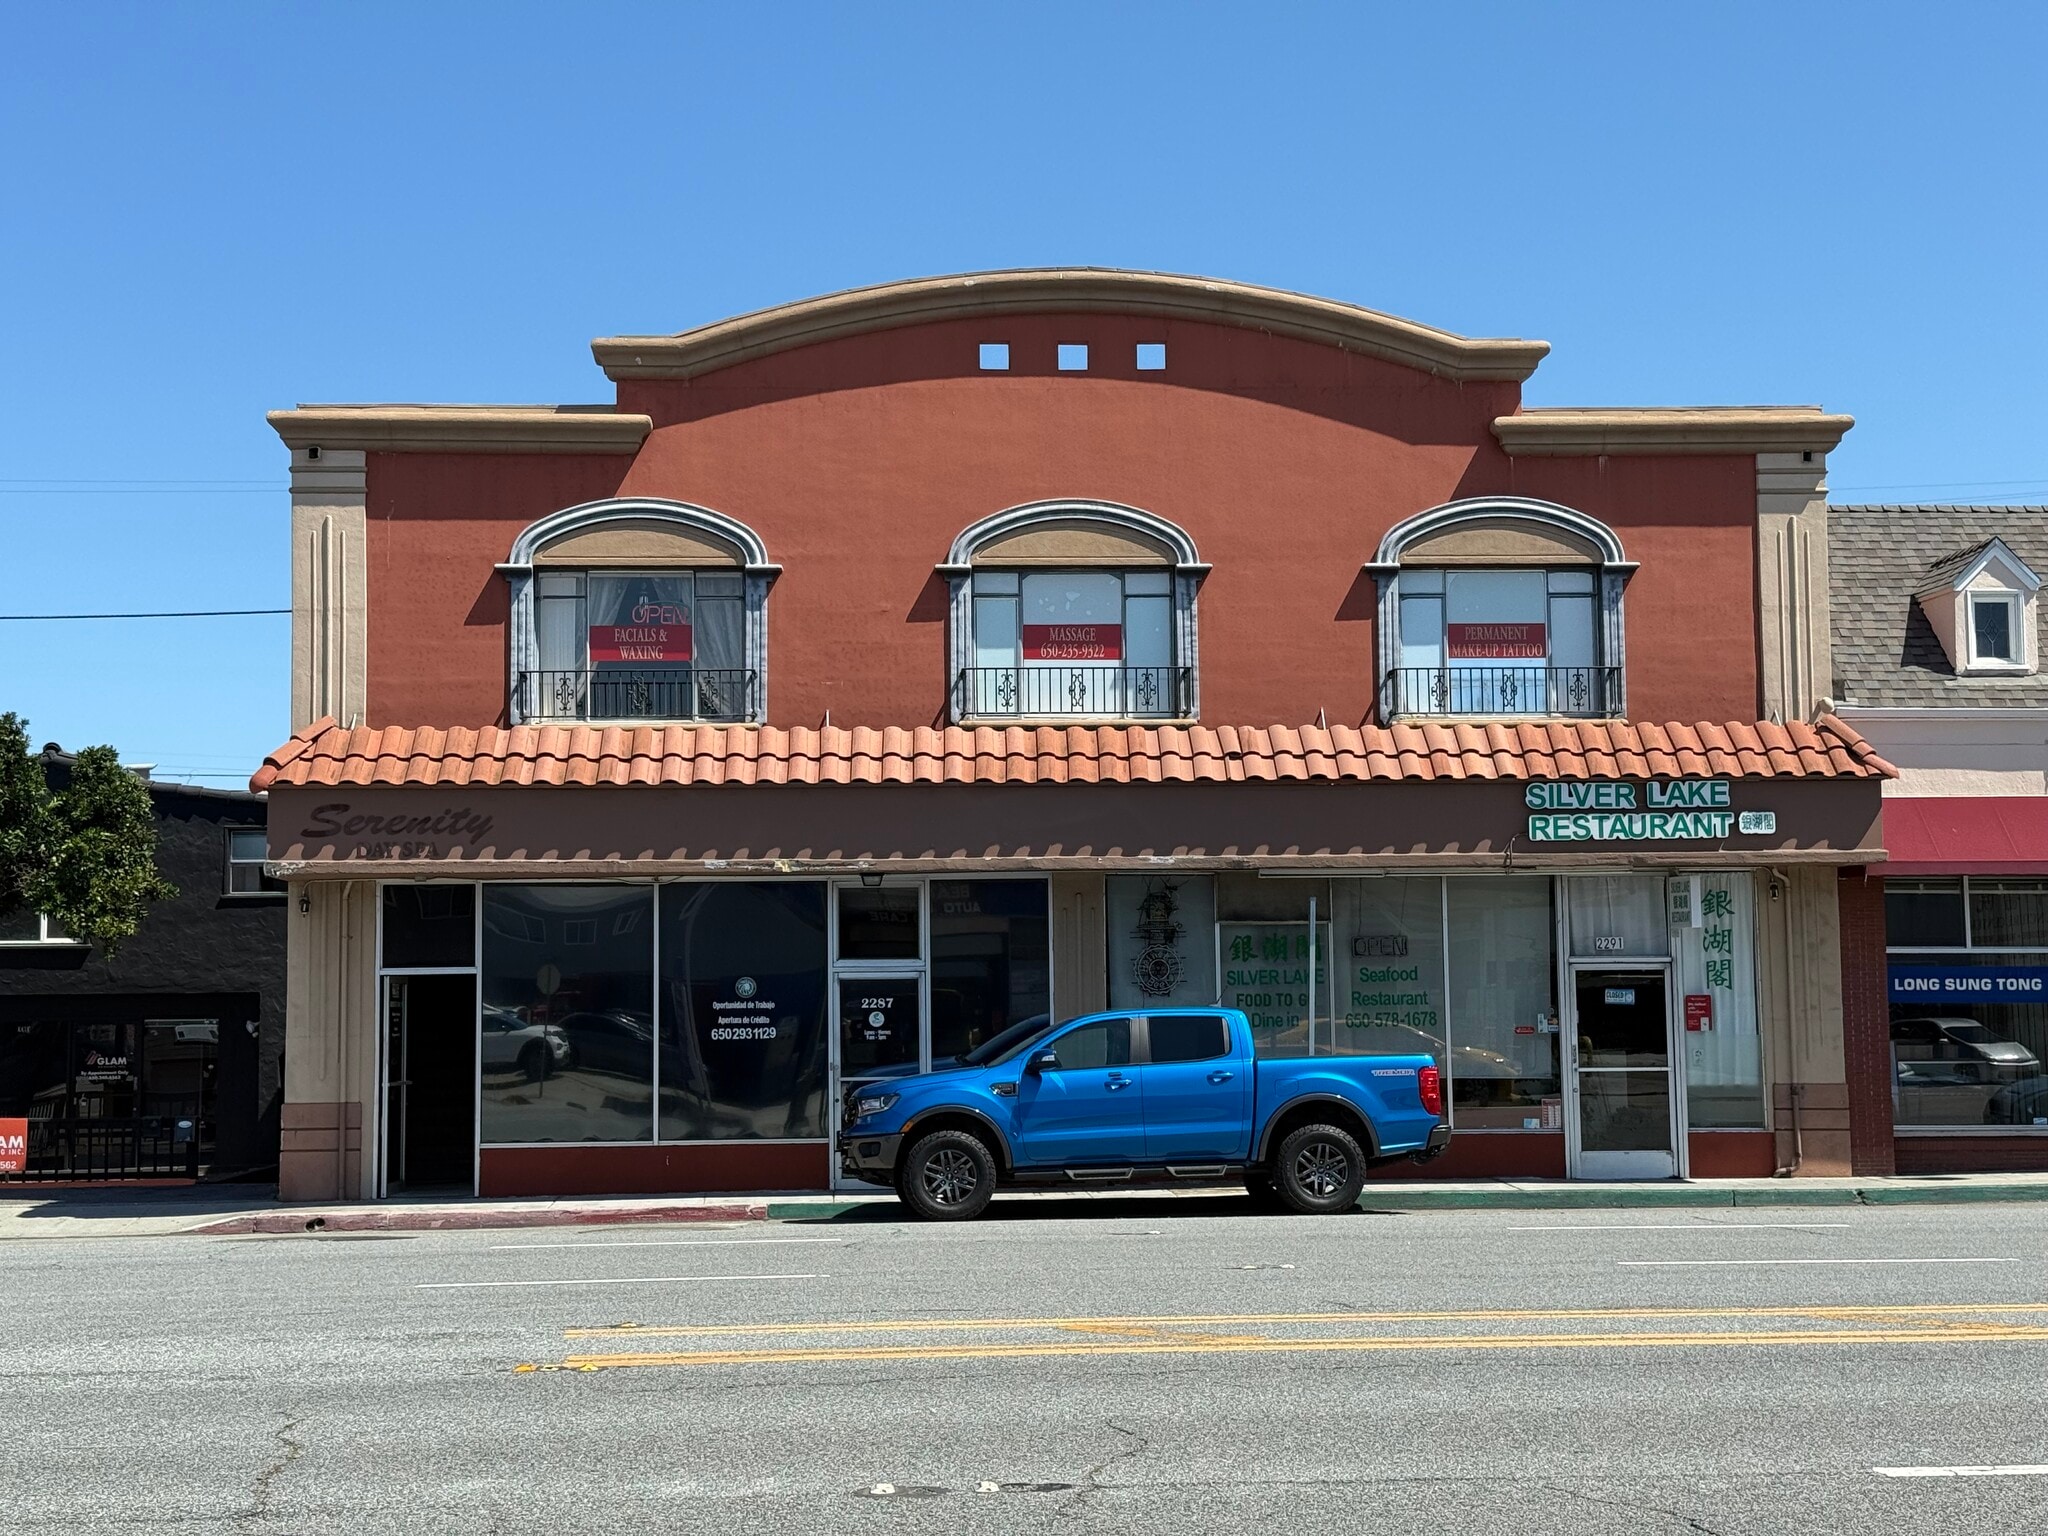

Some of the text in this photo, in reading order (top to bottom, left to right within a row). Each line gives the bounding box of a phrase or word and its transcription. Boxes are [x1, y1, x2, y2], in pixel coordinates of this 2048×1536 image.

[632, 604, 689, 625] OPEN
[614, 628, 668, 642] FACIALS &
[1049, 627, 1097, 642] MASSAGE
[1465, 626, 1529, 640] PERMANENT
[619, 645, 664, 660] WAXING
[1040, 643, 1106, 659] 650-235-9322
[1452, 643, 1543, 657] MAKE-UP TATTOO
[1526, 780, 1731, 809] SILVER LAKE
[300, 803, 496, 846] Serenity
[1530, 813, 1734, 841] RESTAURANT
[357, 842, 439, 859] DAY SPA
[1354, 936, 1408, 956] OPEN
[1597, 937, 1623, 949] 2291
[1701, 889, 1736, 990] 銀湖閣
[1226, 969, 1280, 986] SILVER
[1360, 965, 1418, 982] Seafood
[1894, 978, 2043, 991] LONG SUNG TONG
[712, 1000, 776, 1010] Oportunidad de Trabajo
[861, 997, 894, 1009] 2287
[1236, 993, 1272, 1007] FOOD
[1275, 993, 1293, 1007] TO
[1352, 991, 1429, 1006] Restaurant
[718, 1015, 742, 1026] Apertura
[1252, 1011, 1299, 1028] Dine in
[1345, 1011, 1437, 1028] 650-578-1678
[97, 1056, 128, 1066] GLAM
[1371, 1069, 1416, 1077] TREMOR
[8, 1148, 25, 1156] INC.
